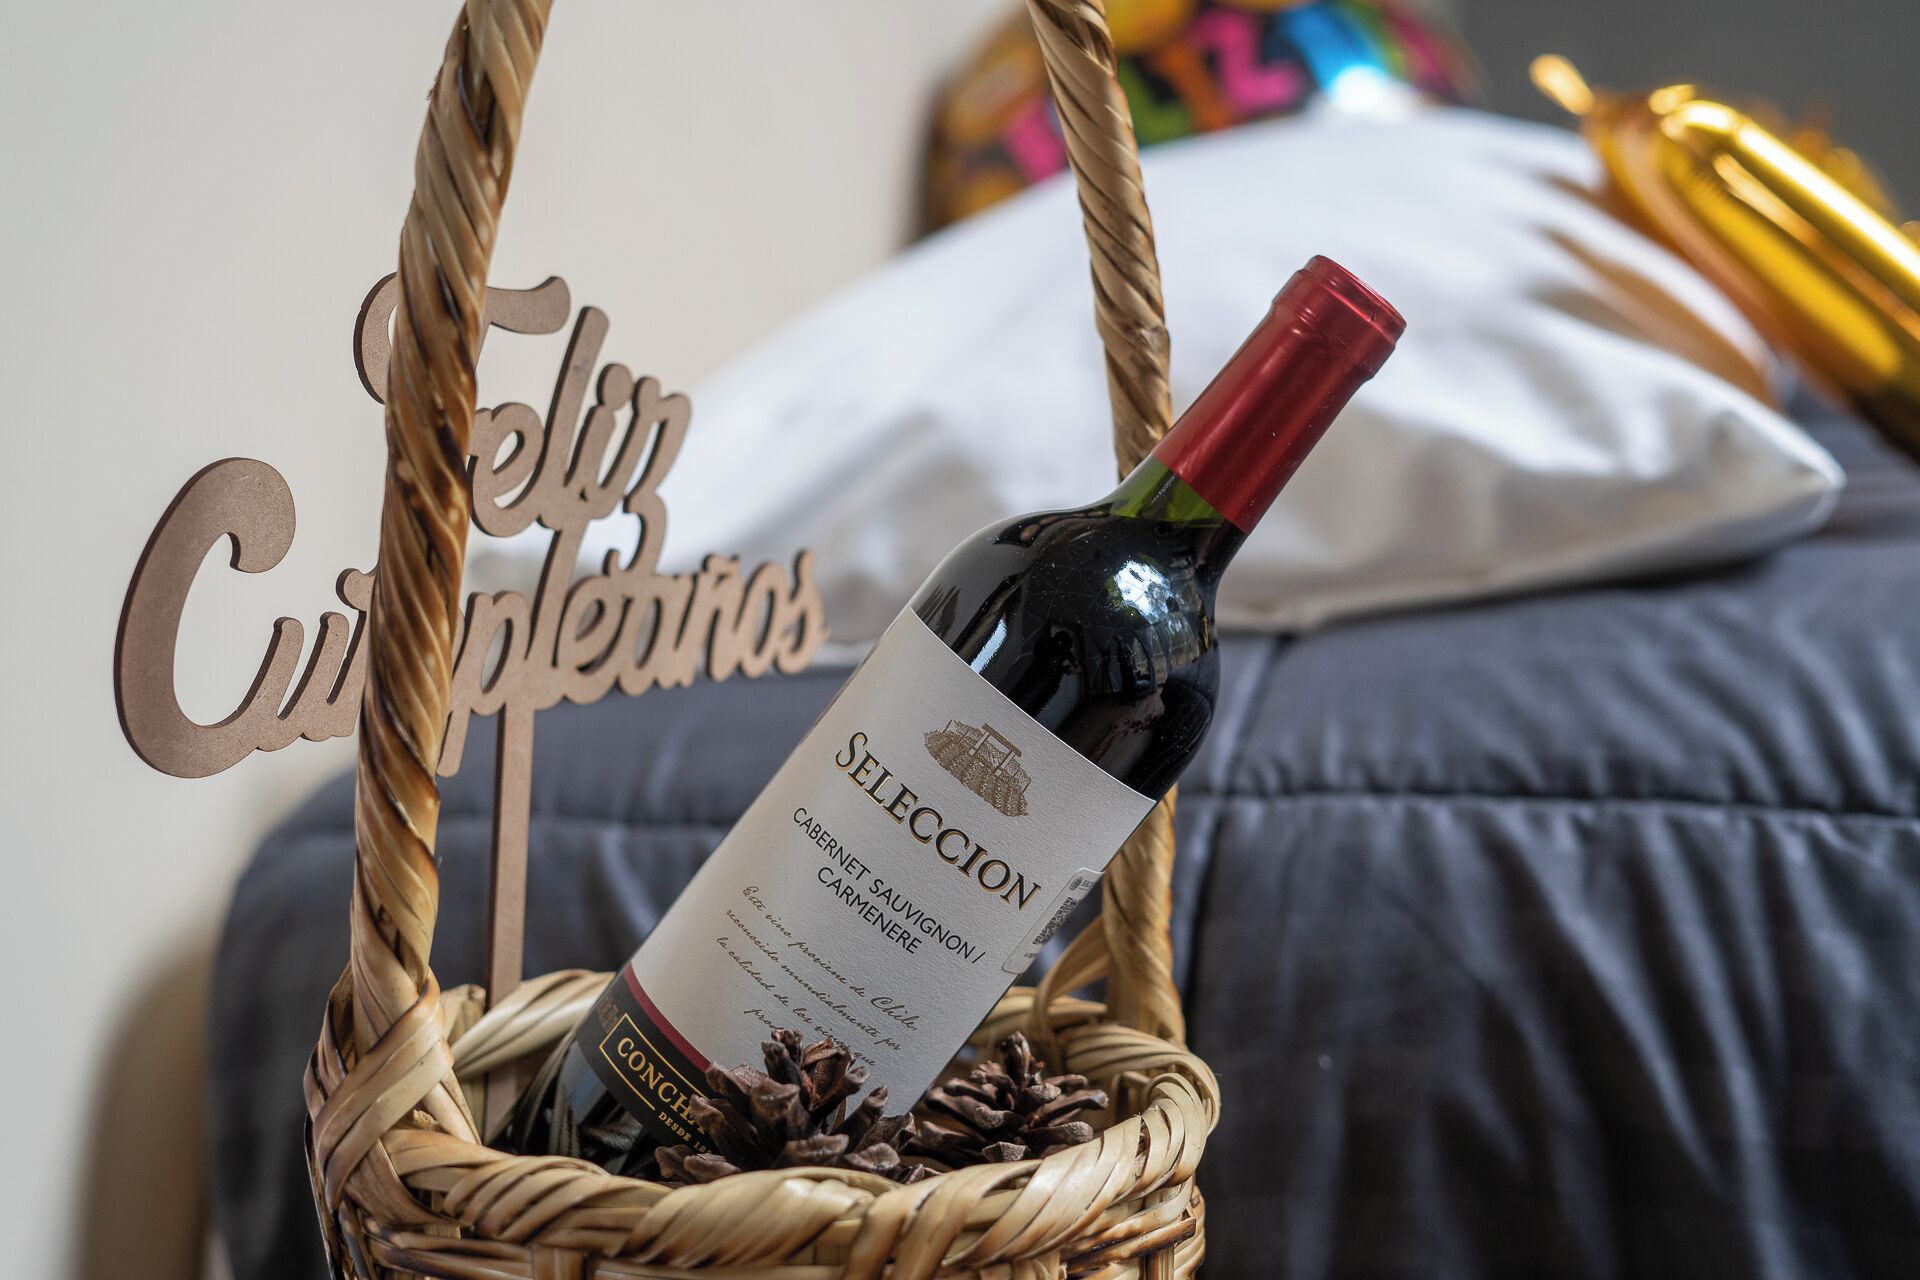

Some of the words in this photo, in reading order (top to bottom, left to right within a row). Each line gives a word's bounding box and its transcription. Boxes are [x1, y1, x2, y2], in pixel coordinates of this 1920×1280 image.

[793, 807, 871, 881] CABERNET
[835, 731, 1042, 911] SELECCION
[742, 886, 767, 912] Este
[765, 913, 793, 938] vino
[787, 941, 847, 984] proviene
[849, 984, 866, 998] de
[870, 996, 920, 1031] Chile,
[817, 866, 923, 954] CARMENERE
[716, 937, 729, 950] la
[728, 951, 776, 992] calidad
[773, 993, 790, 1007] de
[792, 1007, 813, 1024] los
[815, 1026, 851, 1051] vino
[726, 909, 780, 963] reconocido
[780, 964, 882, 1038] mundialmente
[873, 1037, 902, 1051] por
[743, 1008, 786, 1031] prod
[617, 1037, 705, 1134] CONCH
[658, 1112, 692, 1142] DESDE
